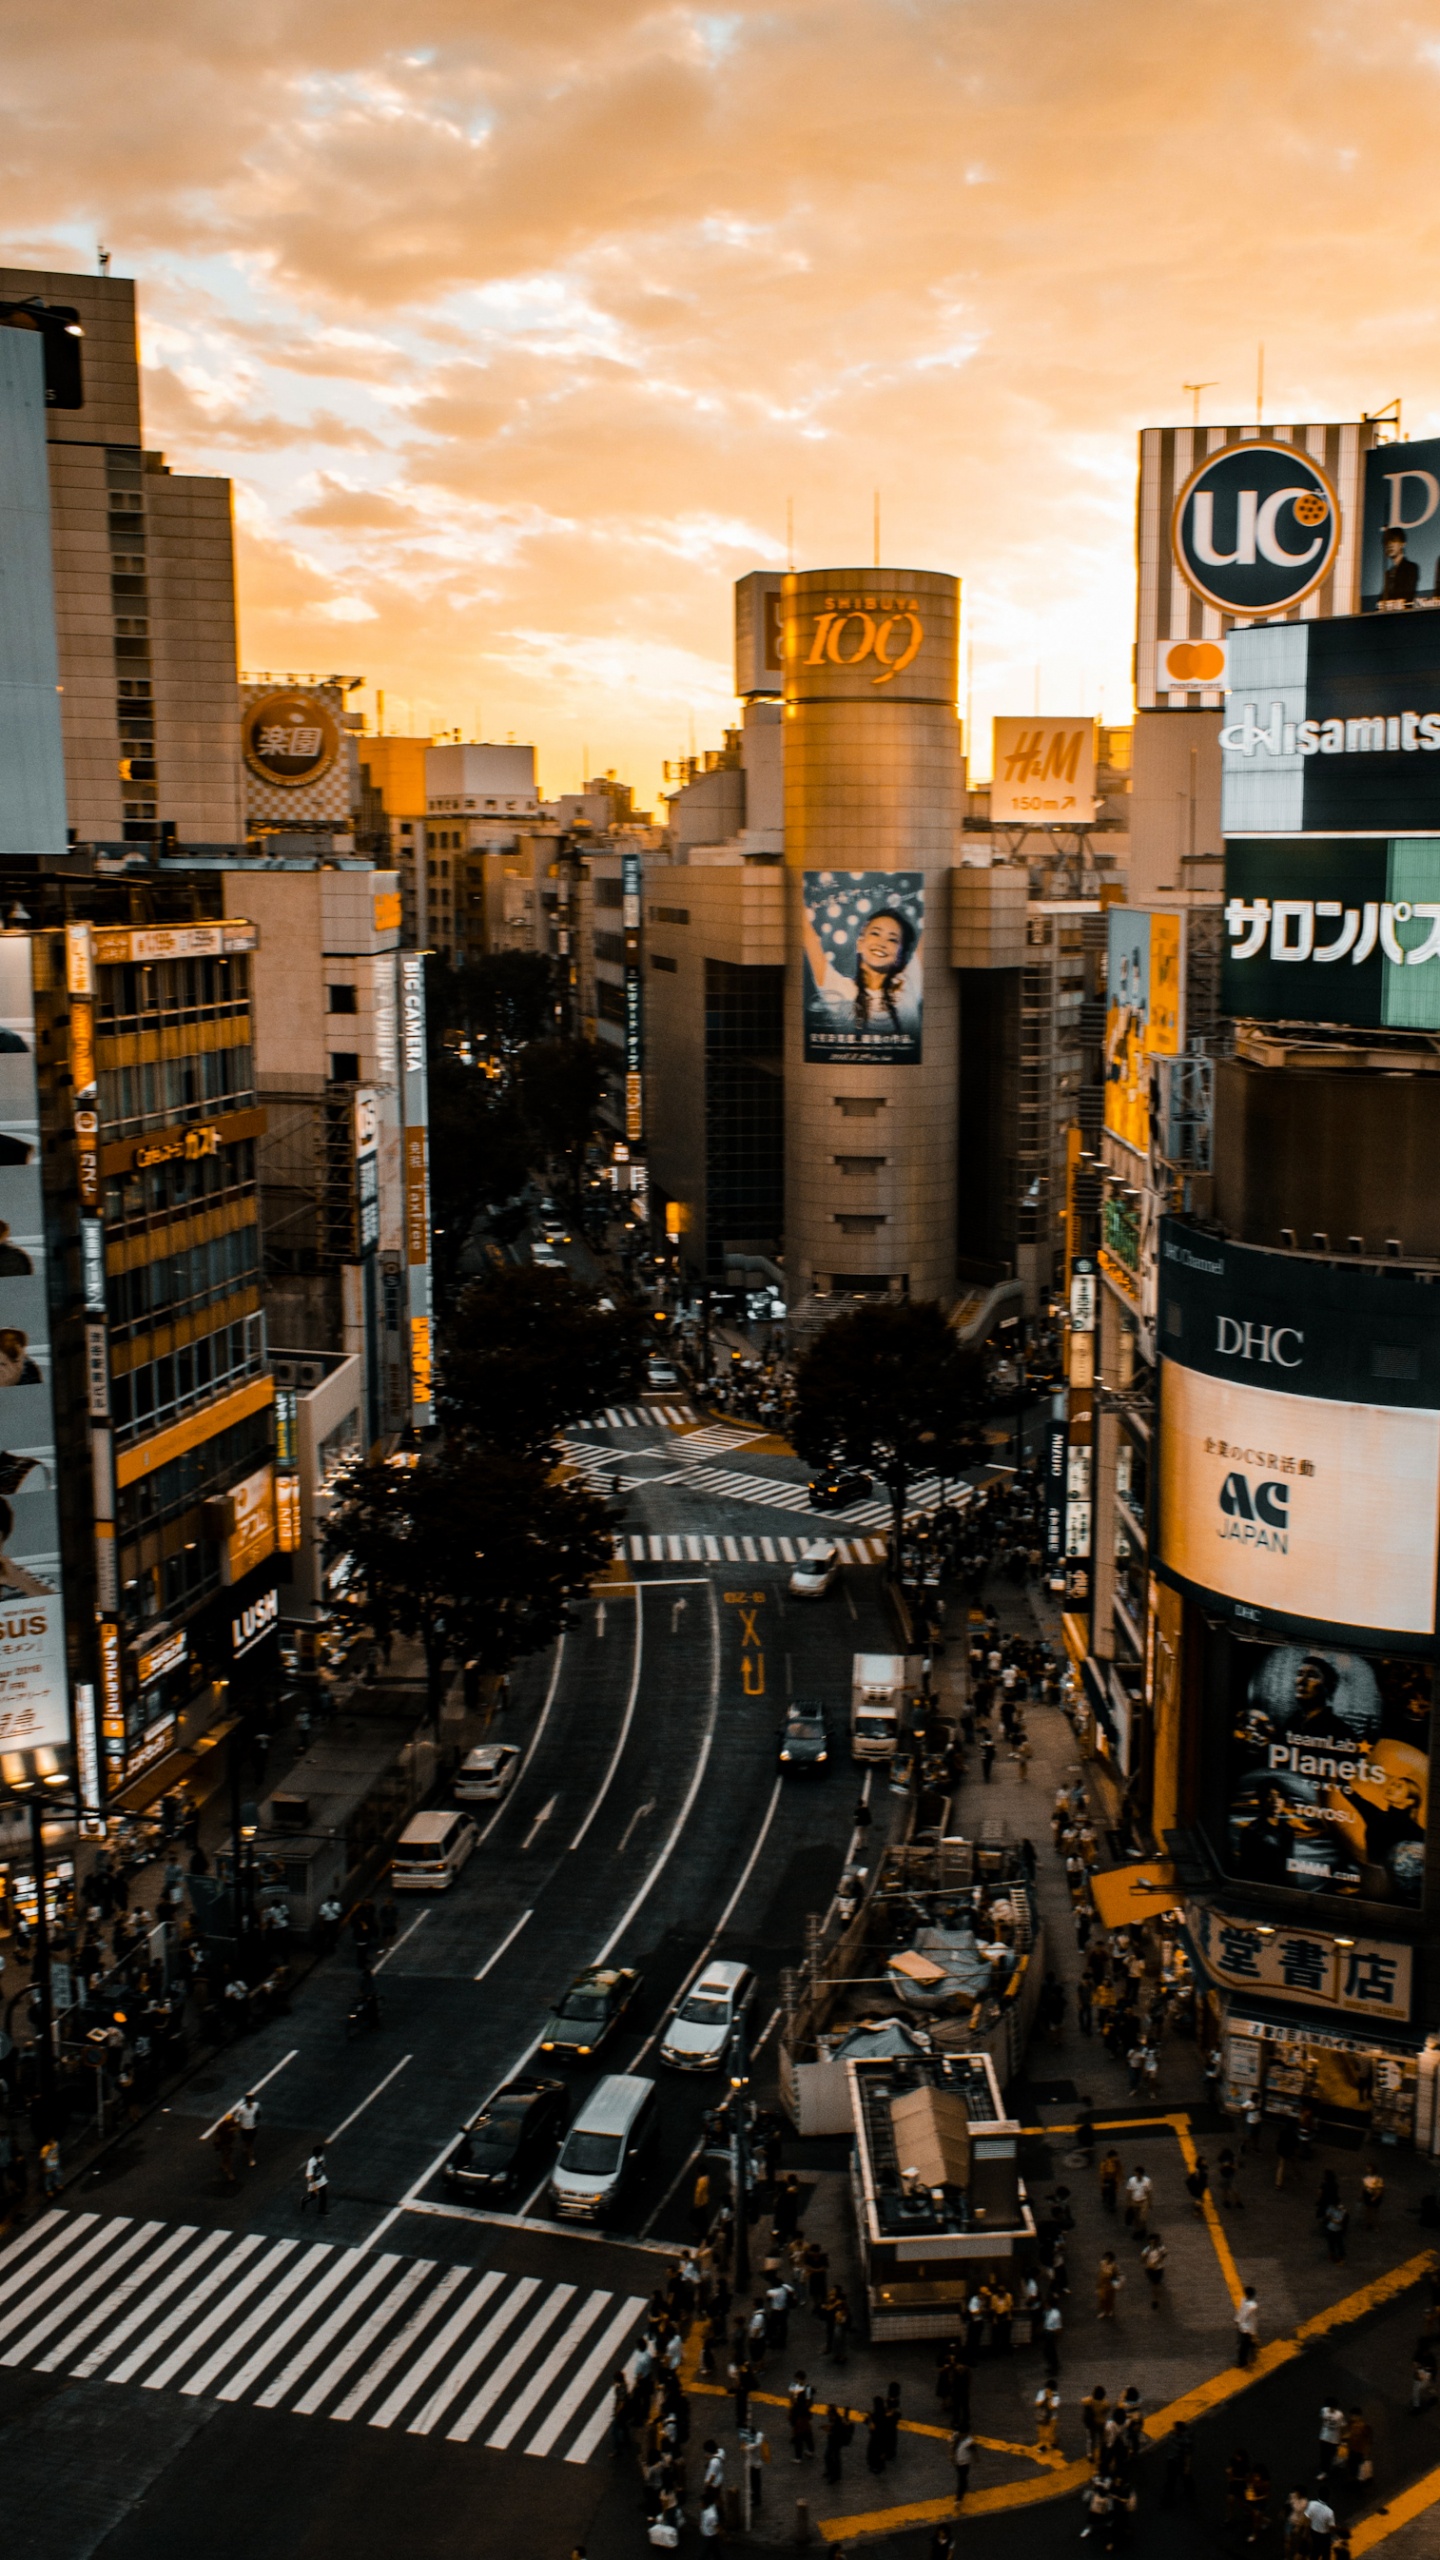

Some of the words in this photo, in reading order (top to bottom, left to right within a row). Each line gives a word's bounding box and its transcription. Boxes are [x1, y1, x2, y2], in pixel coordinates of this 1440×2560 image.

[825, 597, 920, 613] SHIBUYA
[802, 612, 924, 685] 109
[257, 726, 323, 757] 楽園
[1003, 730, 1085, 785] H&M
[1012, 796, 1061, 811] 150m
[403, 961, 422, 991] BIC
[404, 994, 424, 1073] CAMERA
[79, 1153, 98, 1197] ガスト
[1181, 1248, 1225, 1276] Channel
[1216, 1315, 1305, 1368] DHC
[1203, 1437, 1317, 1478] 企業のCSR活動
[1219, 1471, 1290, 1530] AC
[1217, 1518, 1289, 1555] JAPAN
[232, 1588, 278, 1648] LUSH
[1235, 1604, 1262, 1622] DHC
[1286, 1730, 1357, 1754] teamLab
[1268, 1743, 1386, 1785] Planets
[1294, 1802, 1357, 1824] TOYOSU
